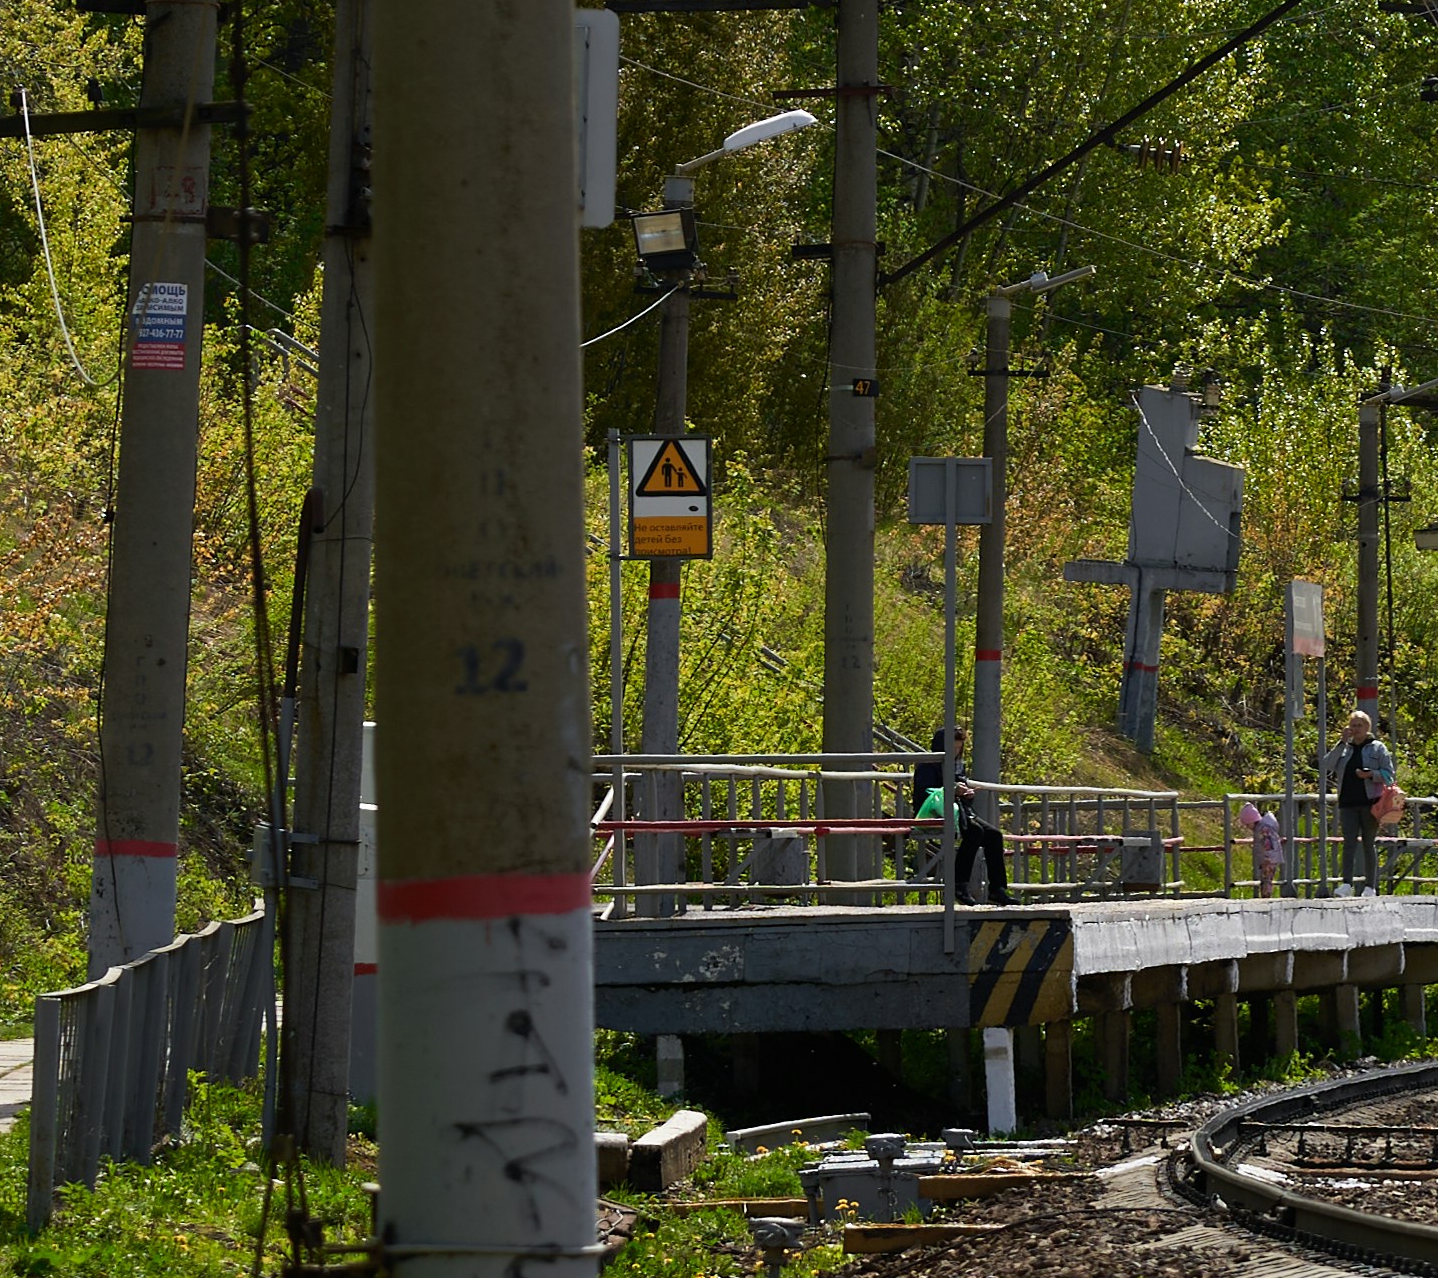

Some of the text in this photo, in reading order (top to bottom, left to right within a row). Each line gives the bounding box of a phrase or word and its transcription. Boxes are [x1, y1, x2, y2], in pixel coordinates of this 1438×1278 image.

[855, 380, 871, 395] 47
[634, 522, 704, 532] Не оставляйте
[635, 534, 683, 545] детей без
[455, 637, 529, 695] 12
